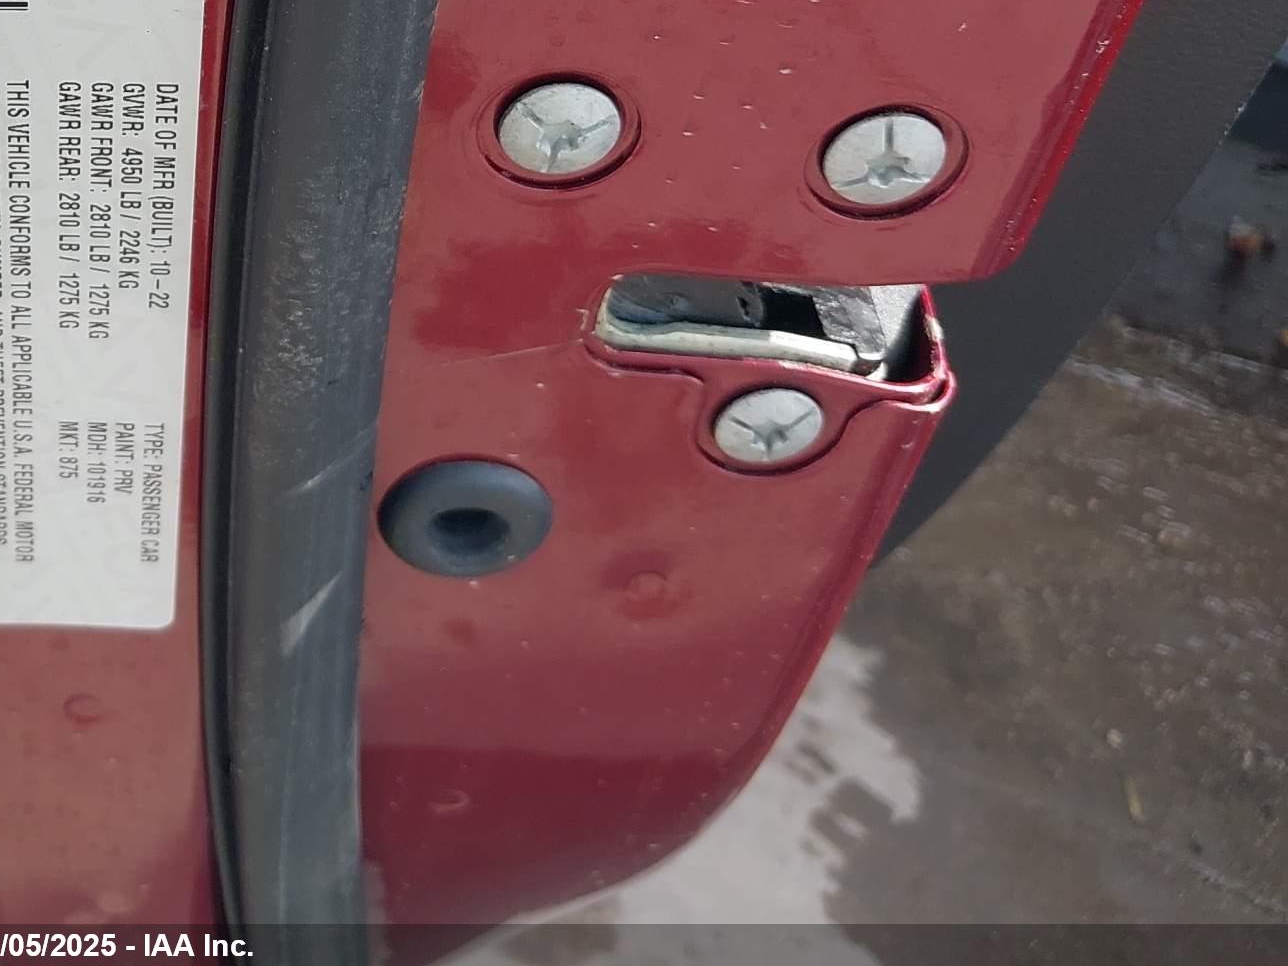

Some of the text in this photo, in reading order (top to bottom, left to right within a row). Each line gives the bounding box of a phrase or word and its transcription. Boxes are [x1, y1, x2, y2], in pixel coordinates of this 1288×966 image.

[59, 82, 81, 129] GAWR
[91, 83, 114, 130] GAWR
[122, 84, 145, 135] GVWR:
[156, 84, 179, 124] DATE
[59, 137, 81, 180] REAR:
[155, 130, 176, 149] OF
[90, 138, 112, 192] FRONT:
[121, 148, 143, 183] 4950
[153, 157, 176, 189] MFR
[59, 193, 80, 227] 2810
[90, 205, 111, 238] 2810
[146, 196, 174, 253] (BUILT):
[119, 231, 141, 264] 2246
[59, 273, 80, 305] 1275
[89, 284, 109, 315] 1275
[119, 271, 139, 288] KG
[7, 80, 34, 562] THIS VEHICLE CONFORMS TO ALL APPLICABLE U.S.A. FEDERAL MOTOR
[59, 311, 80, 328] KG
[89, 322, 109, 338] KG
[59, 422, 78, 478] MKT: 875
[87, 422, 107, 503] MDH: 101916
[114, 423, 135, 494] PAINT: PRV
[141, 423, 164, 562] TYPE: PASSENGER CAR
